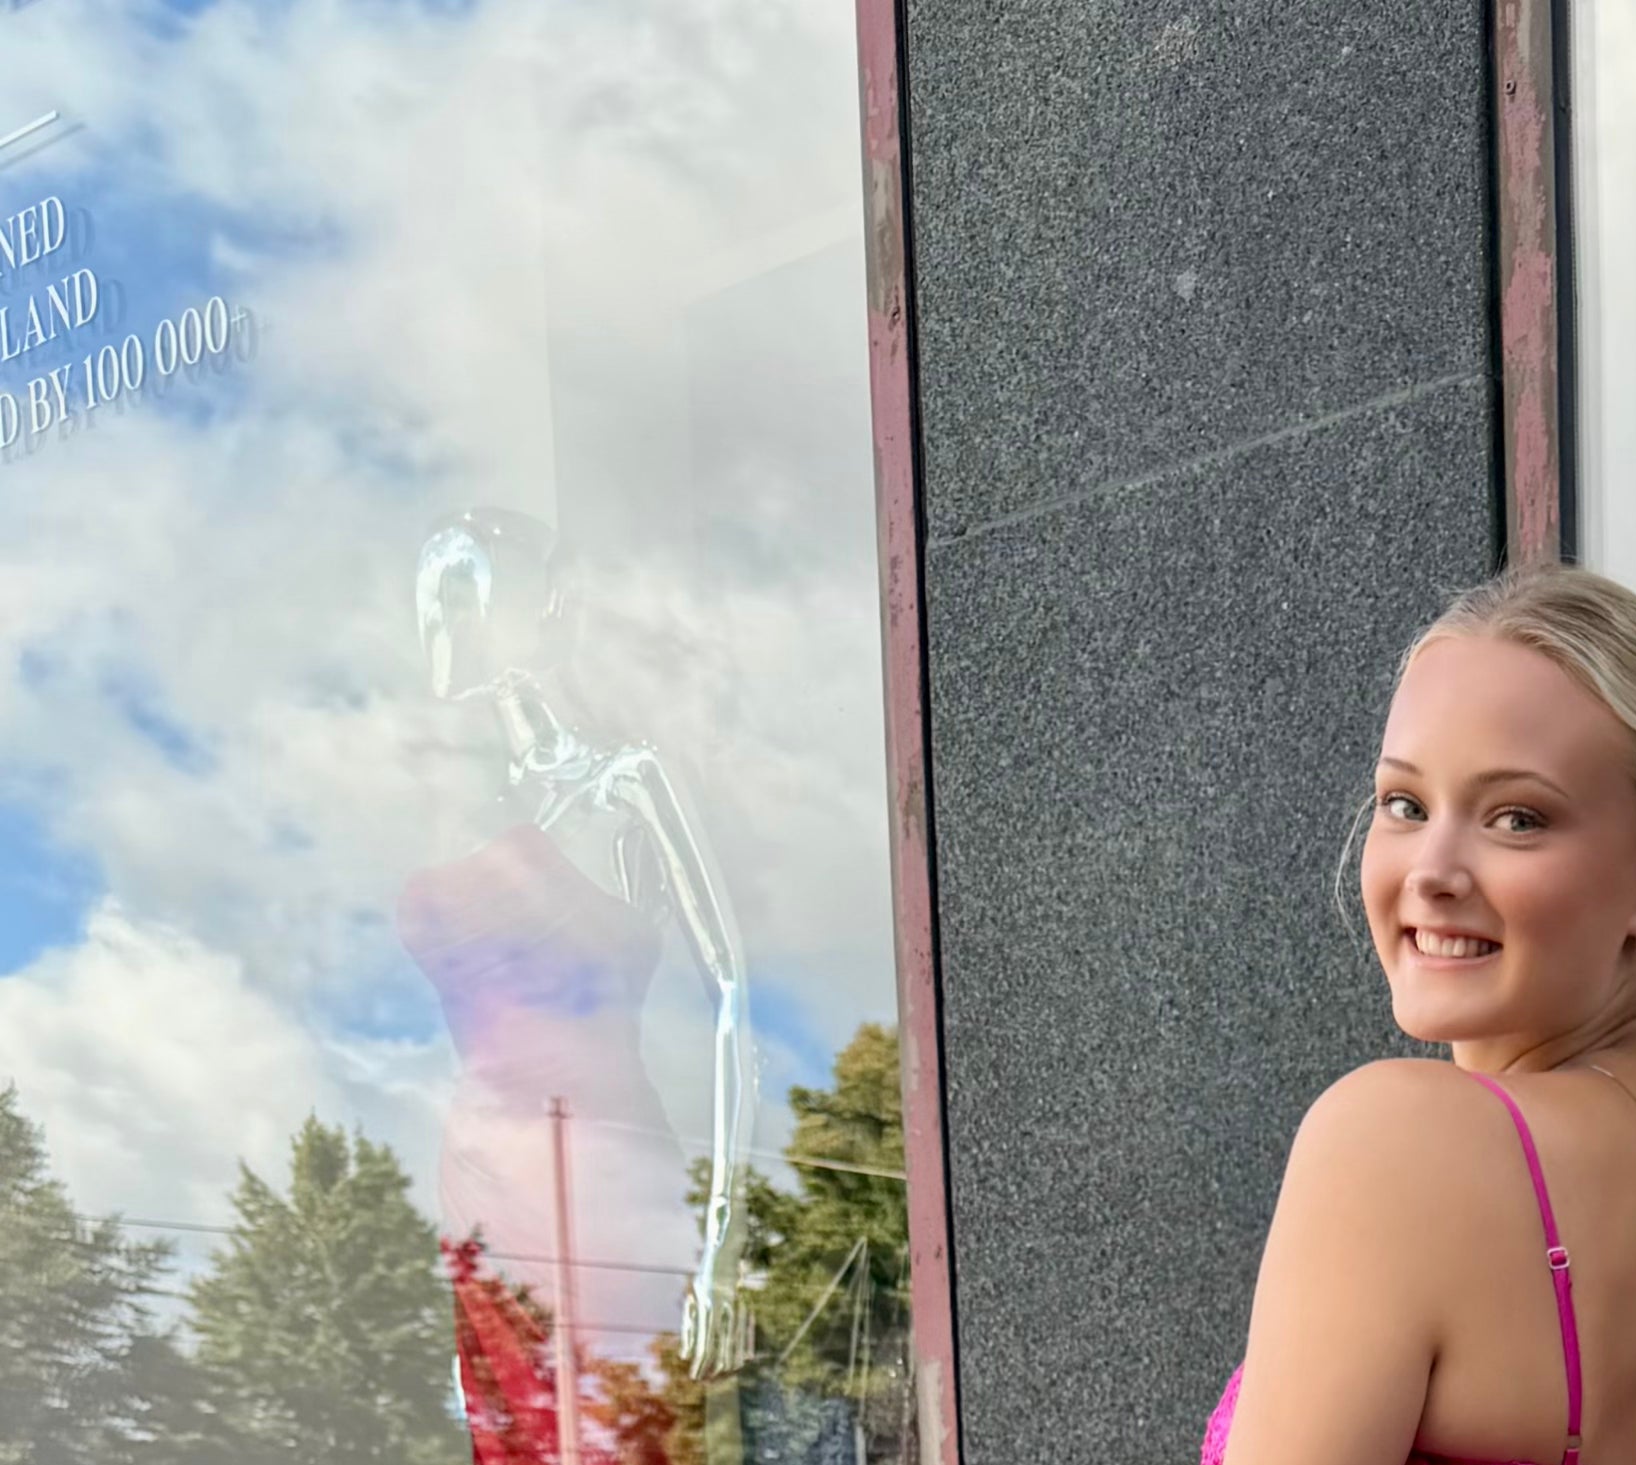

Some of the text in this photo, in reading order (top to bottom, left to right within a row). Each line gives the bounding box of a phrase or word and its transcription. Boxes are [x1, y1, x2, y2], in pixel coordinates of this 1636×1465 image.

[0, 196, 65, 270] NED
[0, 268, 98, 362] LAND
[27, 362, 72, 435] BY
[83, 334, 144, 410] 100
